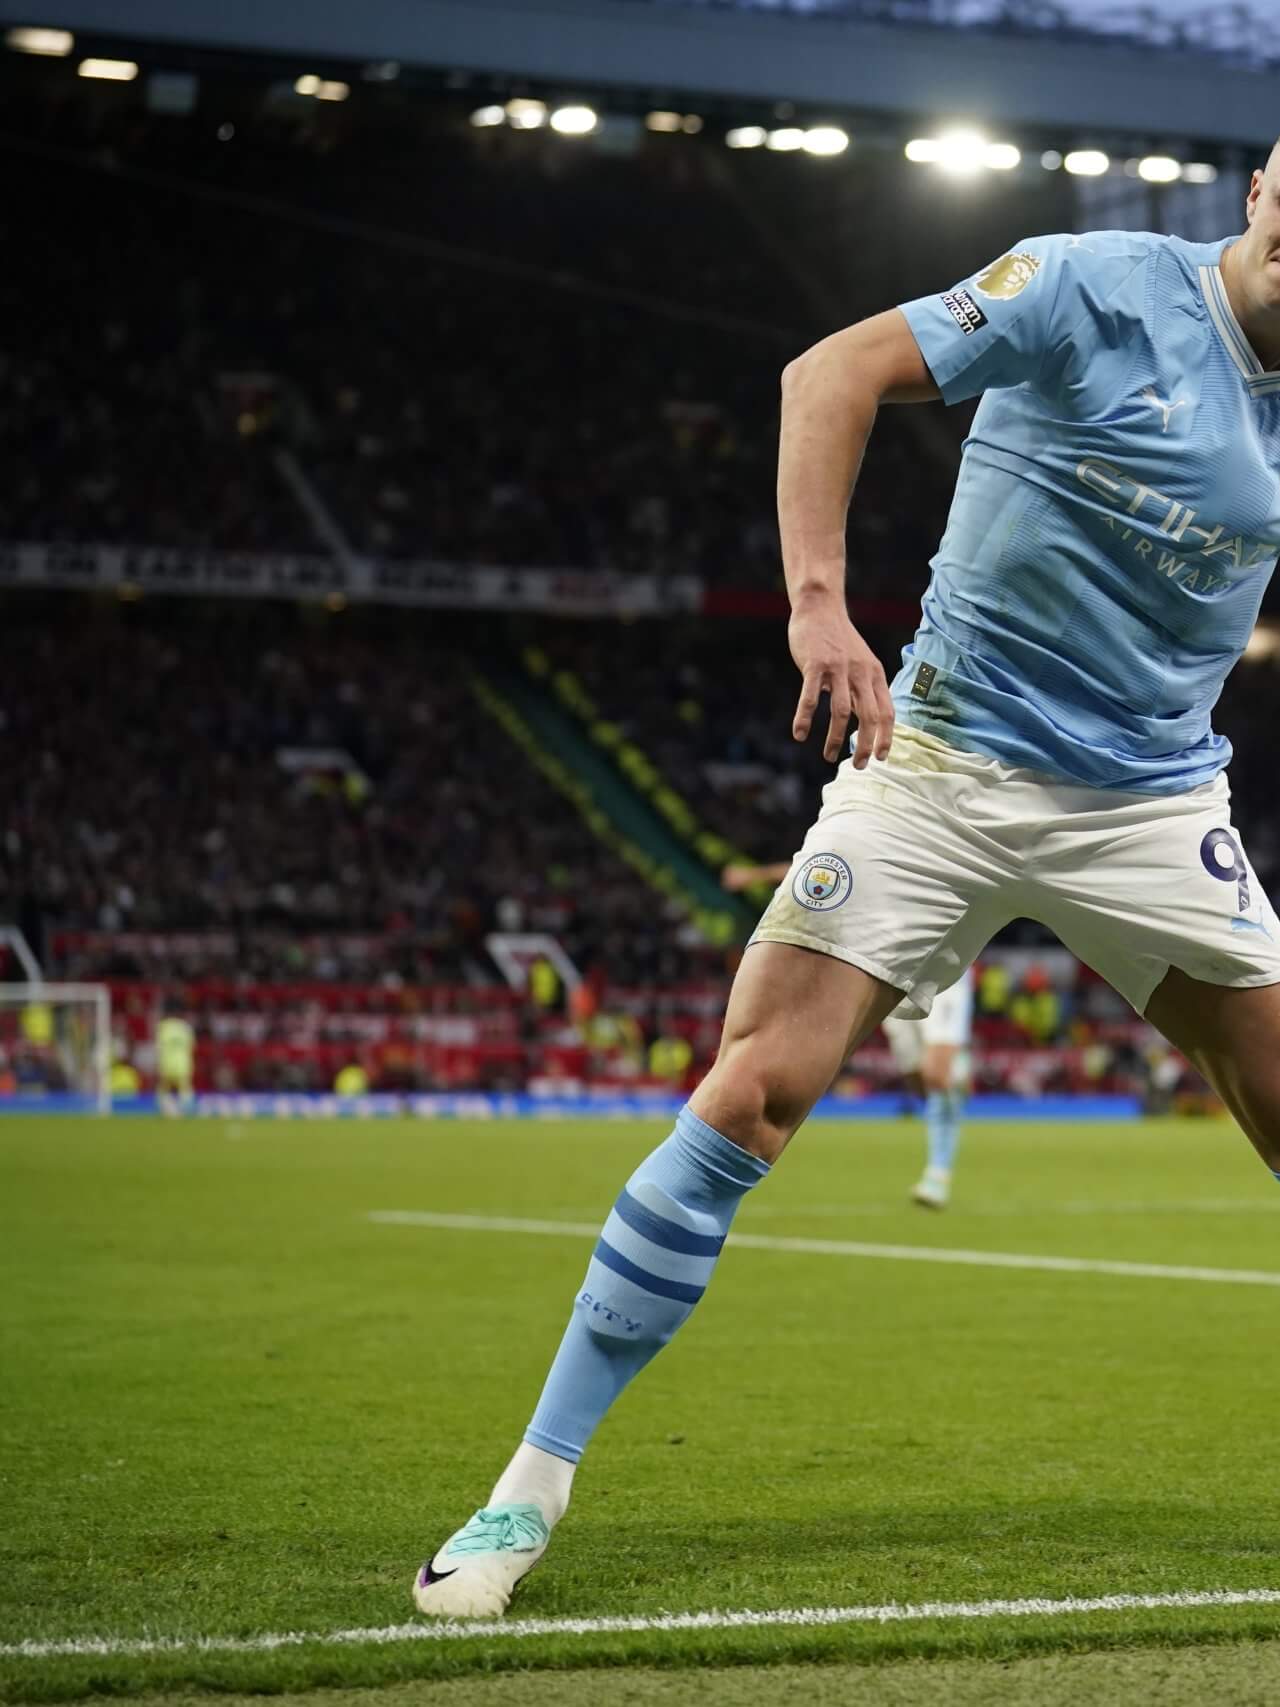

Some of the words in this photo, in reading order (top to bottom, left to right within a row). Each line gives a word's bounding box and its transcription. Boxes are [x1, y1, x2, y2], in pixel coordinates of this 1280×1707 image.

[803, 856, 848, 880] MANCHESTER
[1200, 828, 1250, 913] 9
[805, 899, 824, 907] CITY
[581, 1292, 643, 1332] CITY
